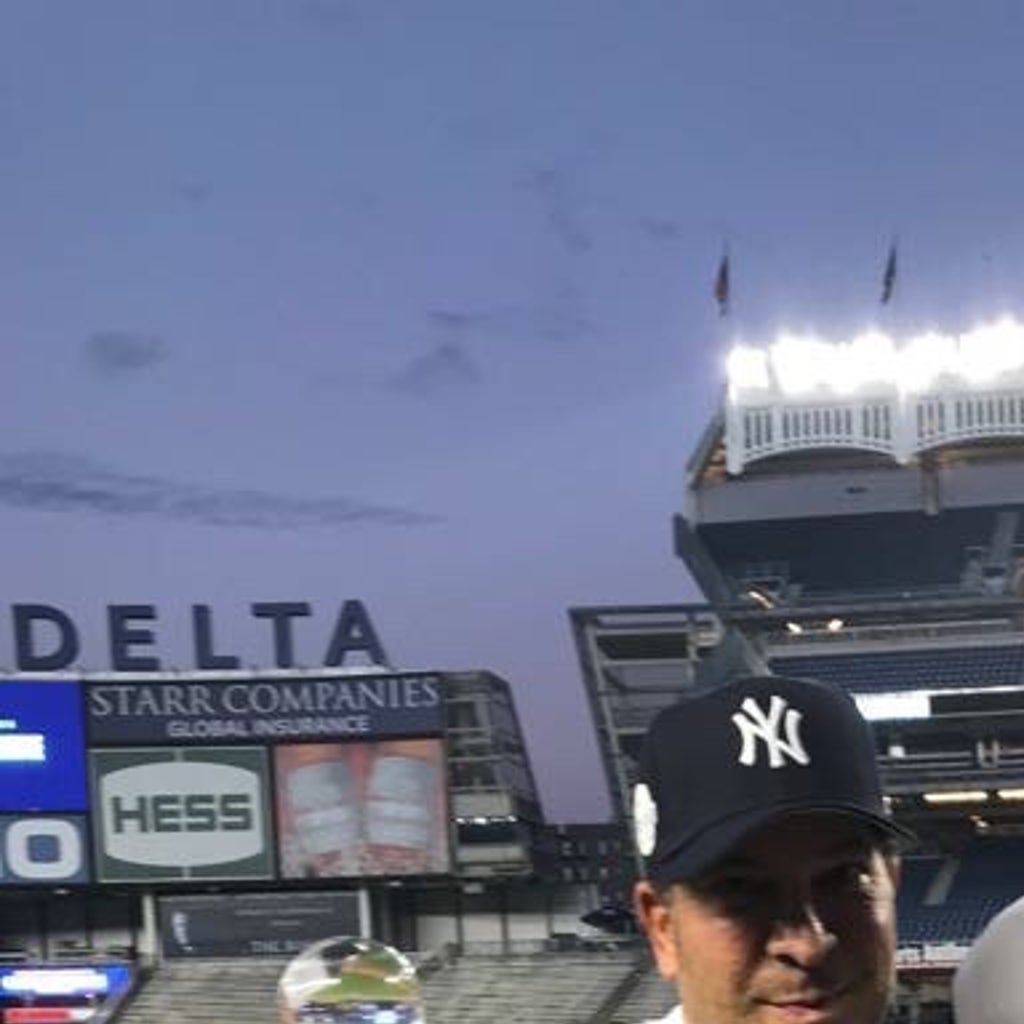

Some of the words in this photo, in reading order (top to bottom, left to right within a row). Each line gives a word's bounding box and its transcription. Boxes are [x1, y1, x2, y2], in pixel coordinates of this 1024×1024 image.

[11, 599, 388, 672] DELTA
[91, 684, 214, 716] STARR
[223, 677, 440, 714] COMPANIES
[167, 719, 247, 737] GLOBAL
[255, 715, 371, 735] INSURANCE
[731, 695, 811, 769] NY
[112, 794, 254, 833] HESS
